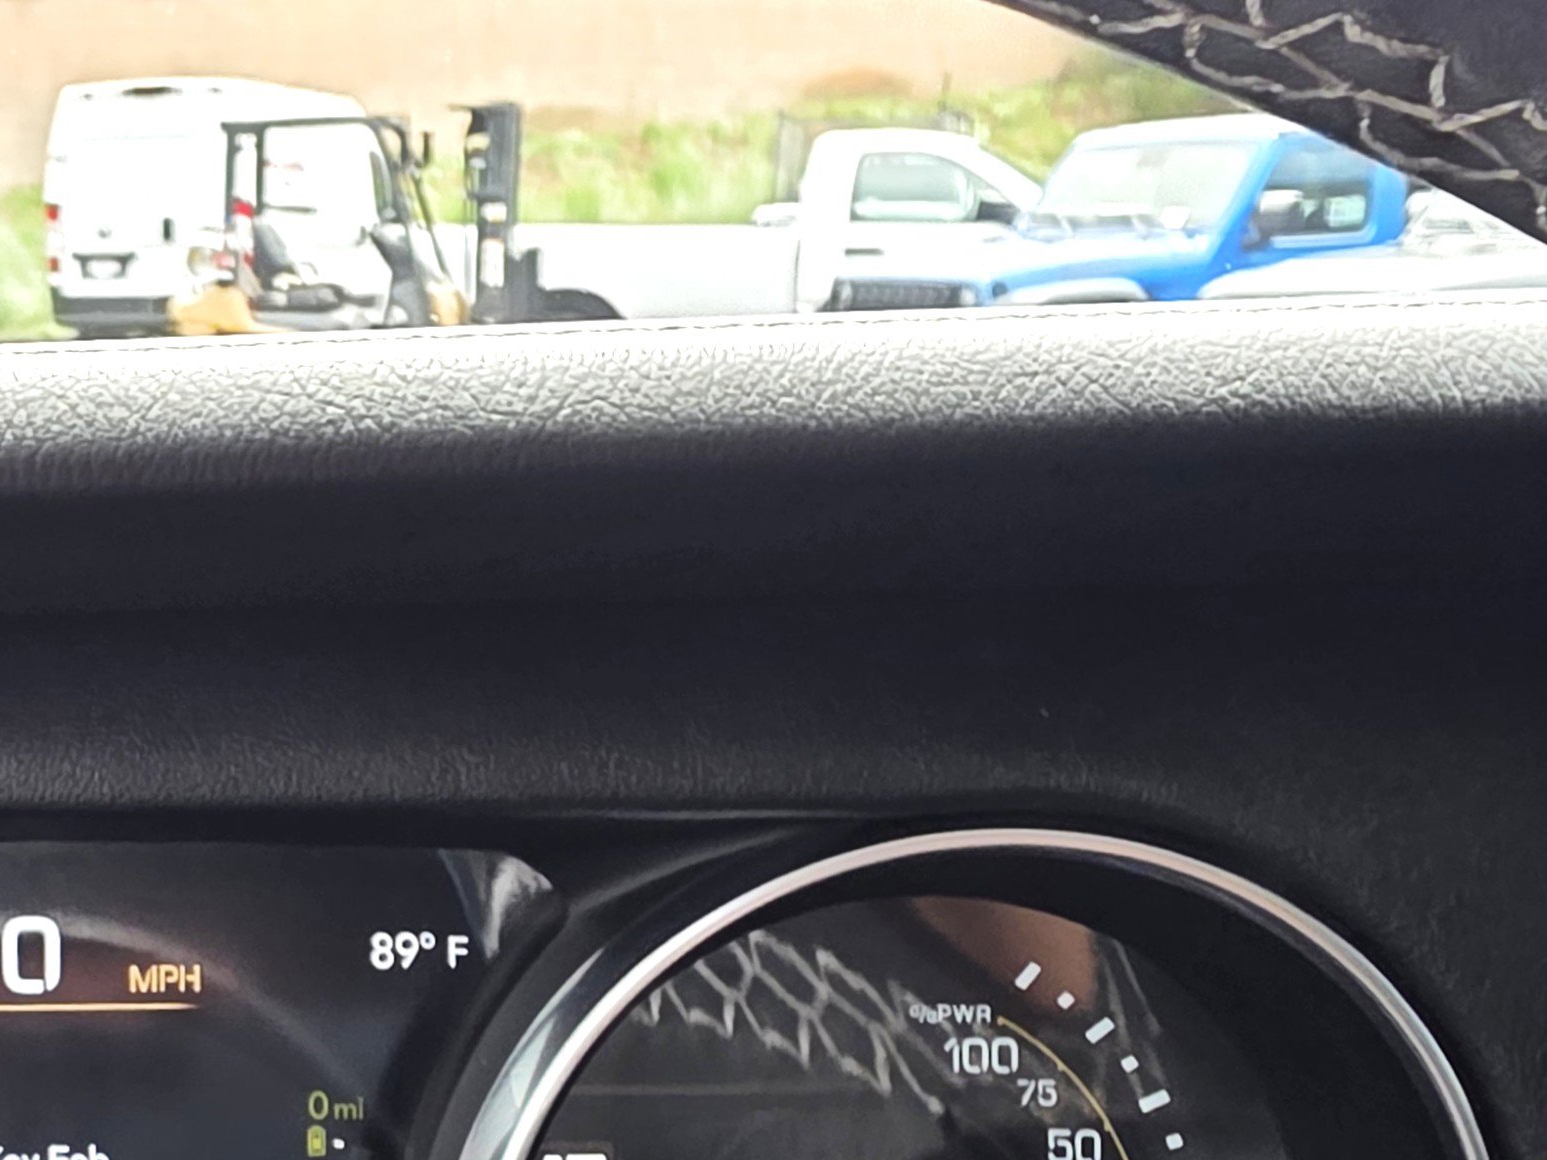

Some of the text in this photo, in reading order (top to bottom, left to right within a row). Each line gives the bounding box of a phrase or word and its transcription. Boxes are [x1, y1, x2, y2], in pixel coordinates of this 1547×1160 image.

[1, 915, 61, 994] 0
[370, 932, 468, 970] 89° F
[129, 964, 201, 993] MPH
[944, 1036, 1019, 1074] 100
[309, 1091, 363, 1119] 0 mi
[1017, 1079, 1057, 1107] 75
